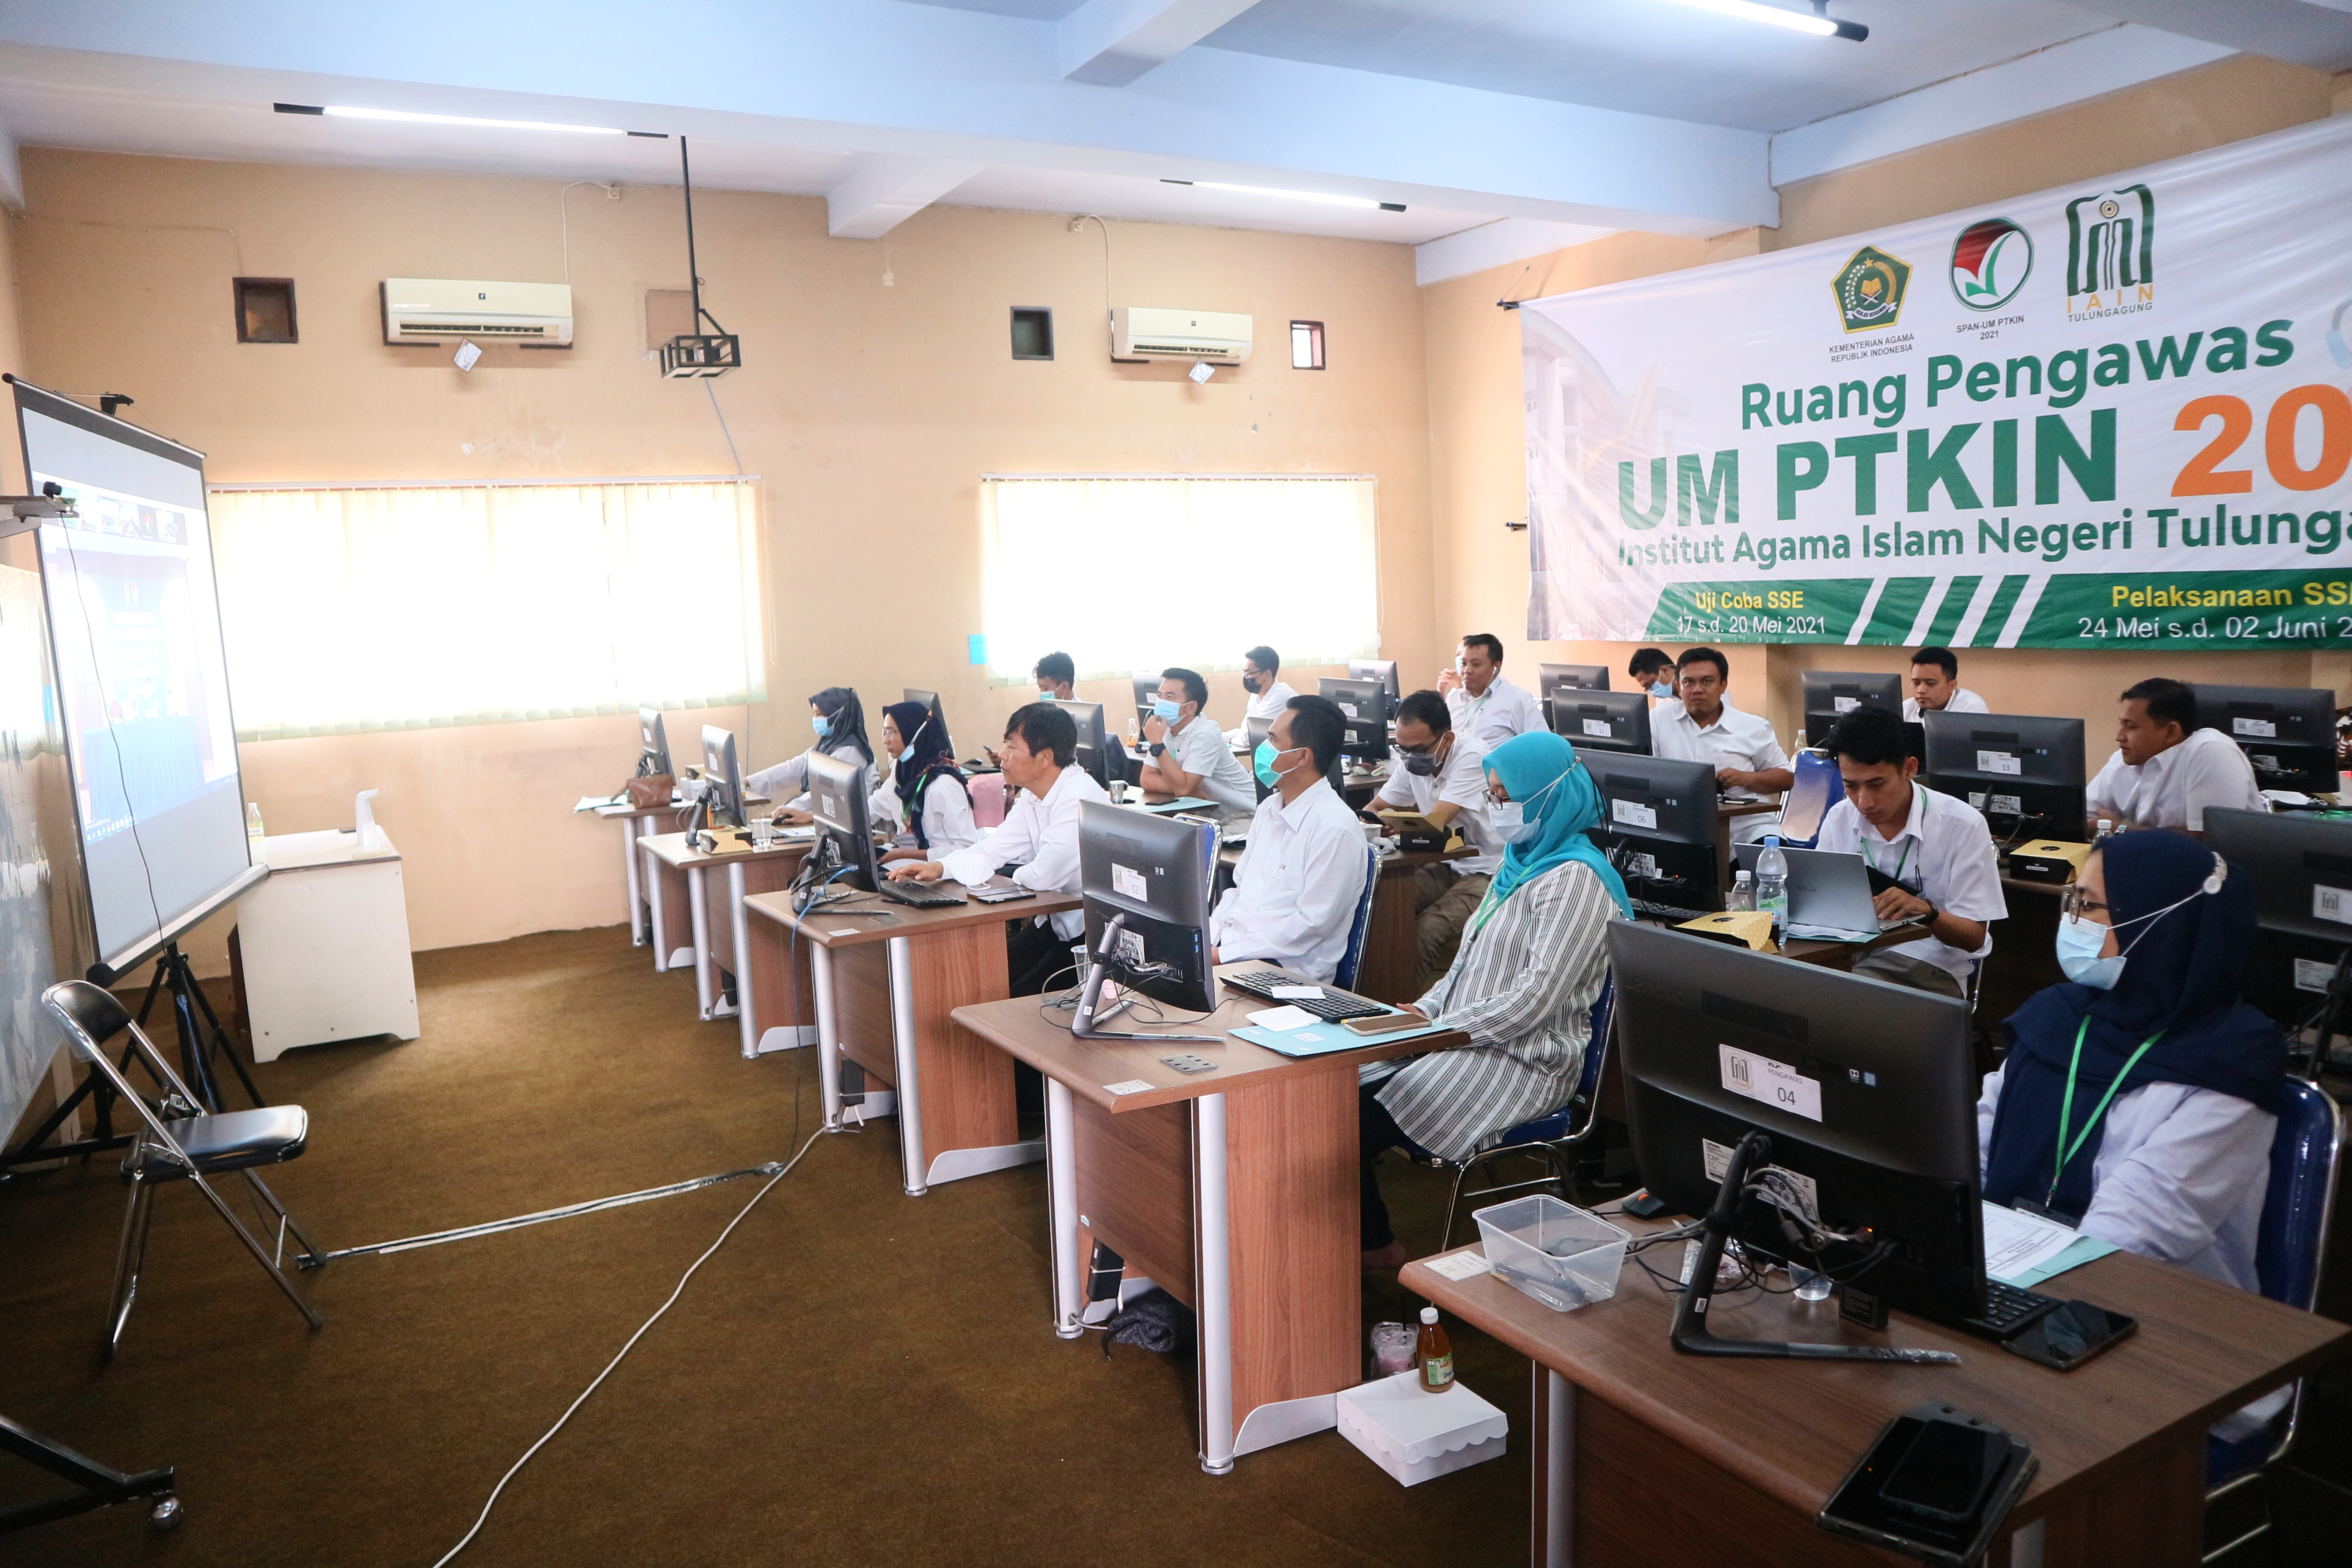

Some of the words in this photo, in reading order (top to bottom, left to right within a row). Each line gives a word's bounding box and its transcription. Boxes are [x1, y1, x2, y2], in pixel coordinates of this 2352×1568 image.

[2067, 284, 2153, 314] IAIN
[2068, 302, 2153, 323] TULUNGAGUNG
[1956, 319, 1995, 333] SPAN-UM
[1998, 315, 2025, 328] PTKIN
[1829, 338, 1883, 354] KEMENTERIAN
[1885, 333, 1915, 345] AGAMA
[1980, 330, 1999, 340] 2021
[1831, 351, 1868, 363] REPUBLIK
[1870, 343, 1913, 357] INDONESIA
[1741, 373, 1906, 430] Ruang
[1927, 318, 2294, 409] Pengawas
[1618, 449, 1739, 530] UM
[1777, 407, 2117, 520] PTKIN
[2171, 384, 2352, 498] 20
[1618, 533, 1724, 566] Institut
[1732, 531, 1850, 570] Agama
[1863, 521, 1964, 559] Islam
[1978, 507, 2132, 563] Negeri
[1695, 592, 1716, 613] Uji
[1721, 591, 1762, 609] Coba
[1767, 590, 1804, 609] SSE
[2112, 585, 2292, 608] Pelaksanaan
[2303, 581, 2352, 606] SS
[1677, 616, 1693, 633] 17
[1698, 616, 1724, 633] s.d.
[1729, 616, 1748, 633] 20
[1753, 616, 1782, 633] Mei
[1786, 616, 1826, 634] 2021
[2078, 617, 2109, 638] 24
[2116, 617, 2160, 638] Mei
[2168, 617, 2215, 638] s.d.
[2225, 616, 2259, 638] 02
[2268, 616, 2327, 639] Juni
[828, 802, 834, 816] 03
[1637, 815, 1646, 823] 06
[1132, 884, 1139, 894] 03
[1768, 1068, 1803, 1084] PENGAWAS
[1778, 1087, 1796, 1106] 04
